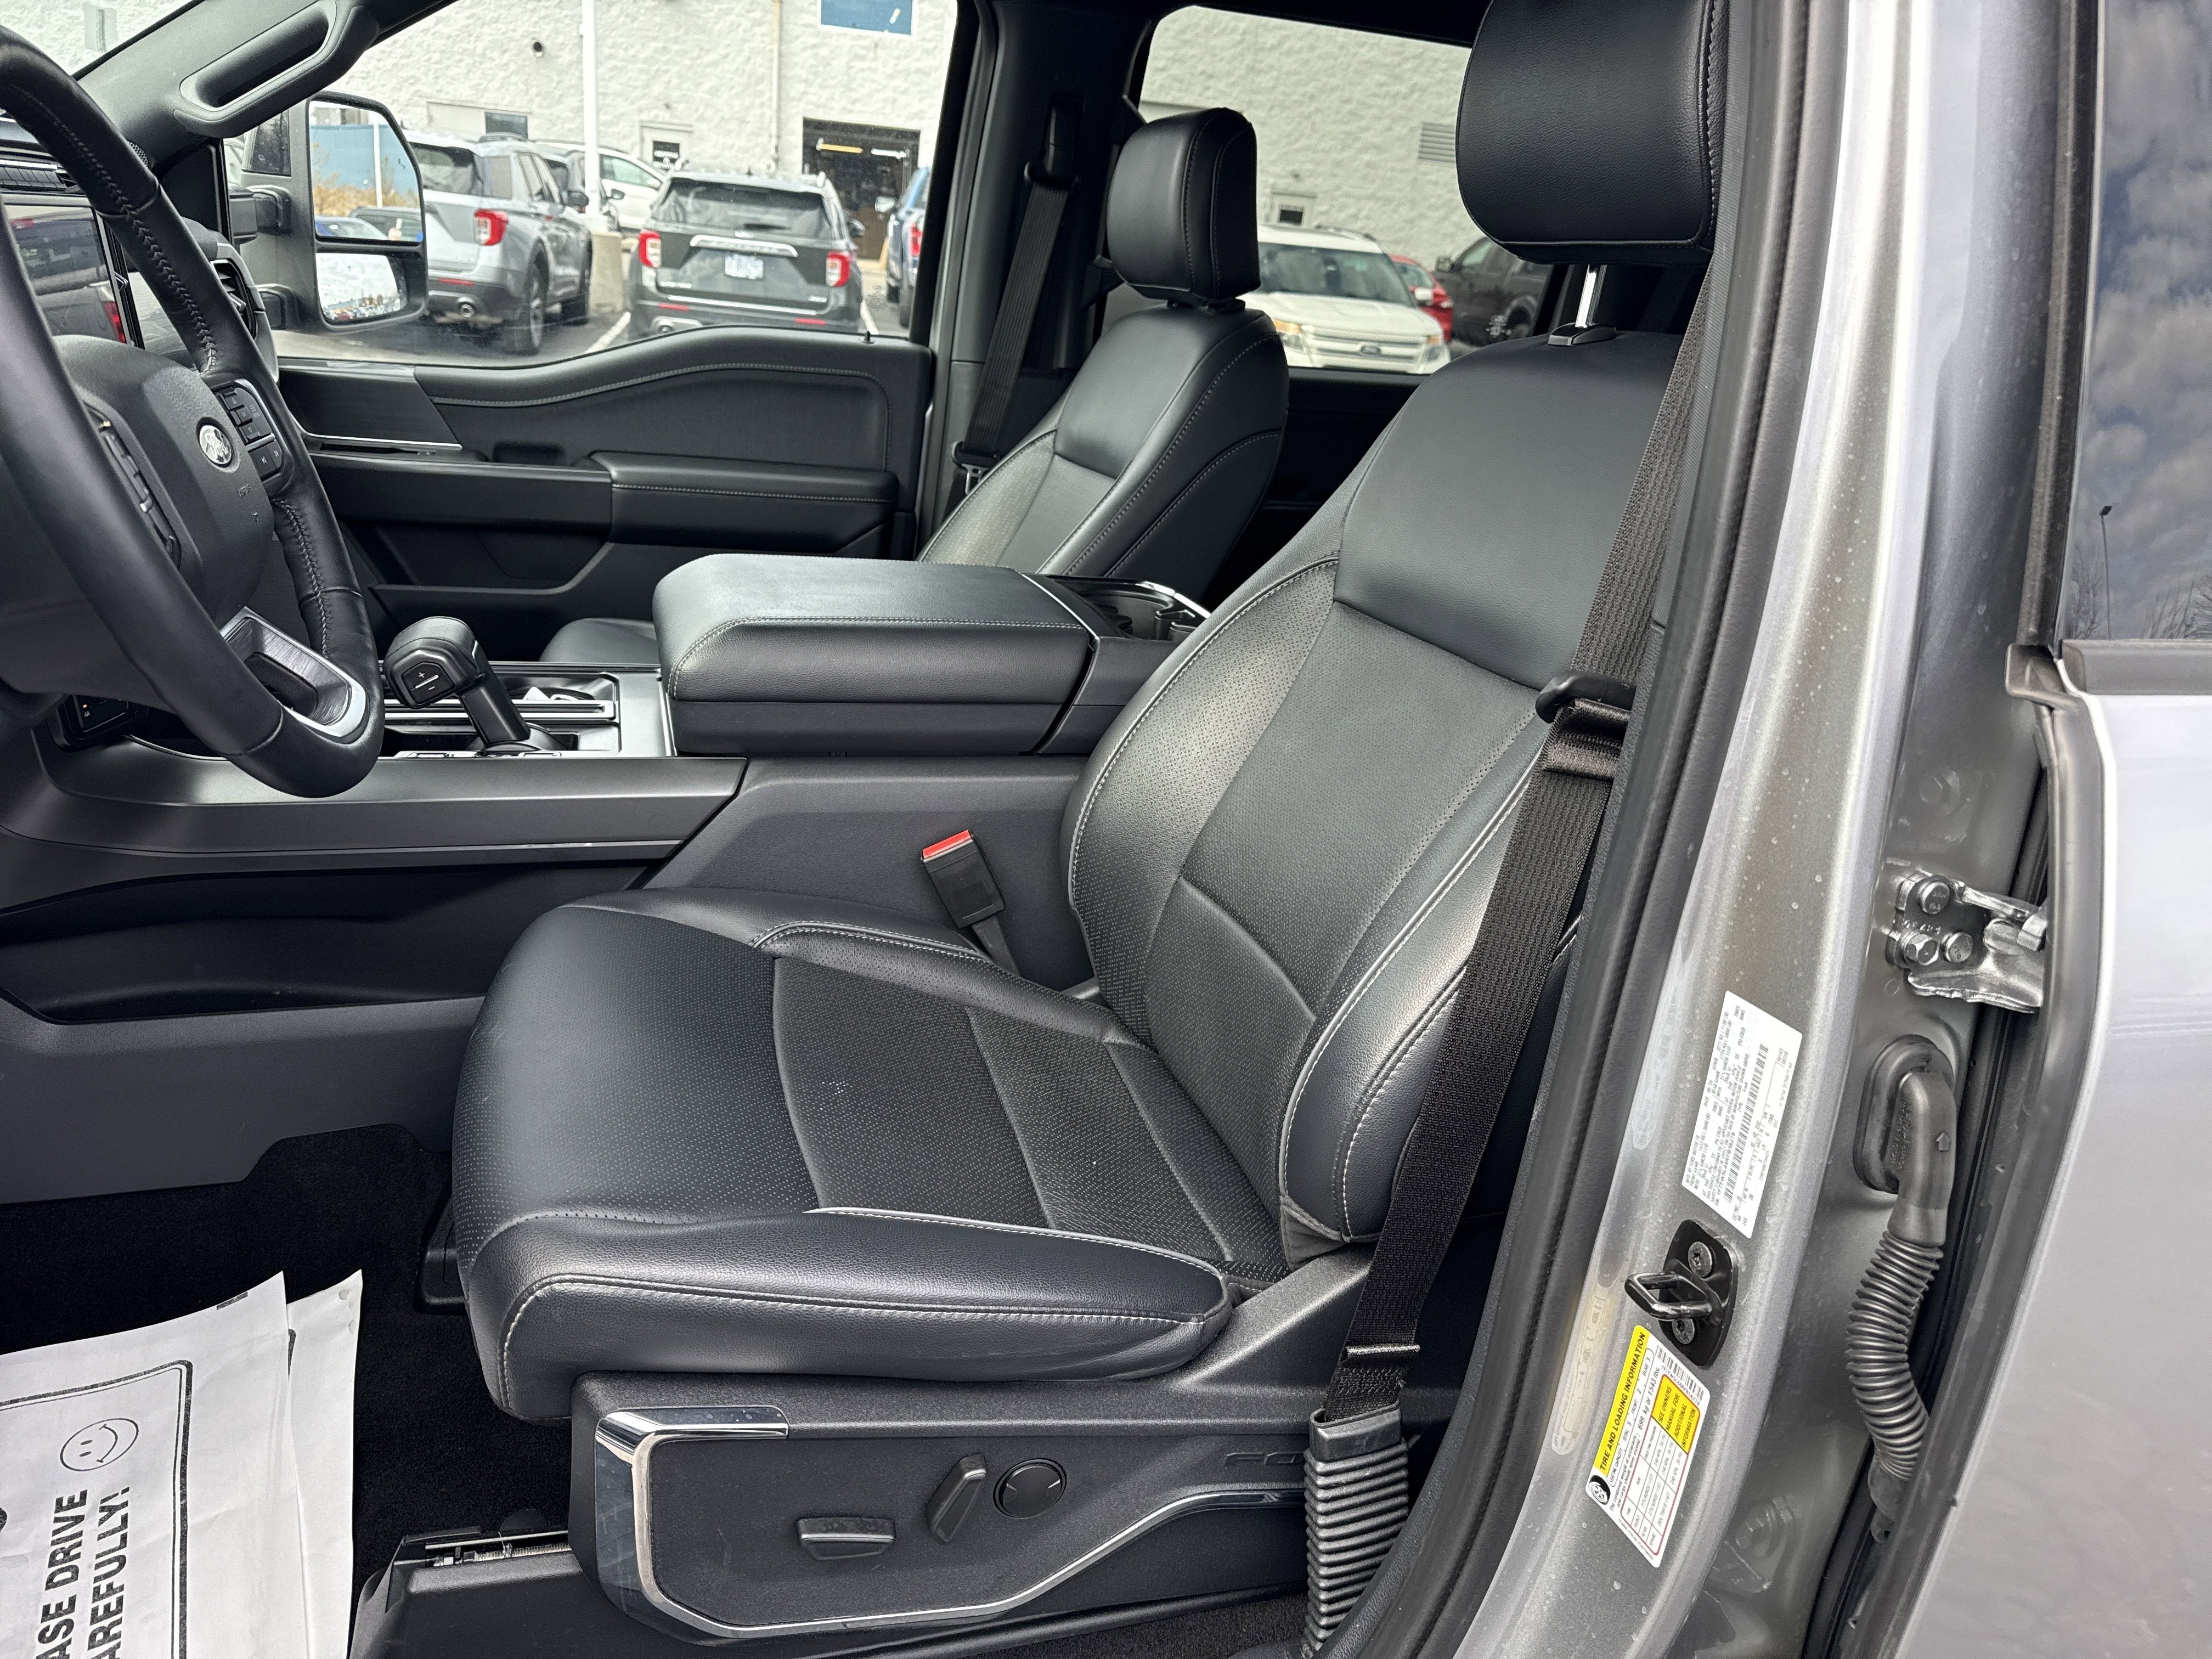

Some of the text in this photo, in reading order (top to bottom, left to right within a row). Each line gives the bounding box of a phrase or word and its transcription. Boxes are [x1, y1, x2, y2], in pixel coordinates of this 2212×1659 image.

[1647, 1378, 1656, 1395] 1543
[1661, 1385, 1672, 1411] OWNERS
[1599, 1332, 1645, 1470] TIRE AND LOADING INFORMATION
[1642, 1405, 1649, 1415] kg
[1646, 1396, 1651, 1405] or
[1665, 1407, 1676, 1431] MANUAL
[1674, 1403, 1687, 1438] ADDITIONAL
[1681, 1407, 1696, 1448] INFORMATION
[1225, 1452, 1305, 1466] FO
[1613, 1480, 1622, 1502] combined
[1627, 1435, 1637, 1458] occupants
[1614, 1447, 1623, 1467] CAPACITY
[44, 1489, 88, 1591] DRIVE
